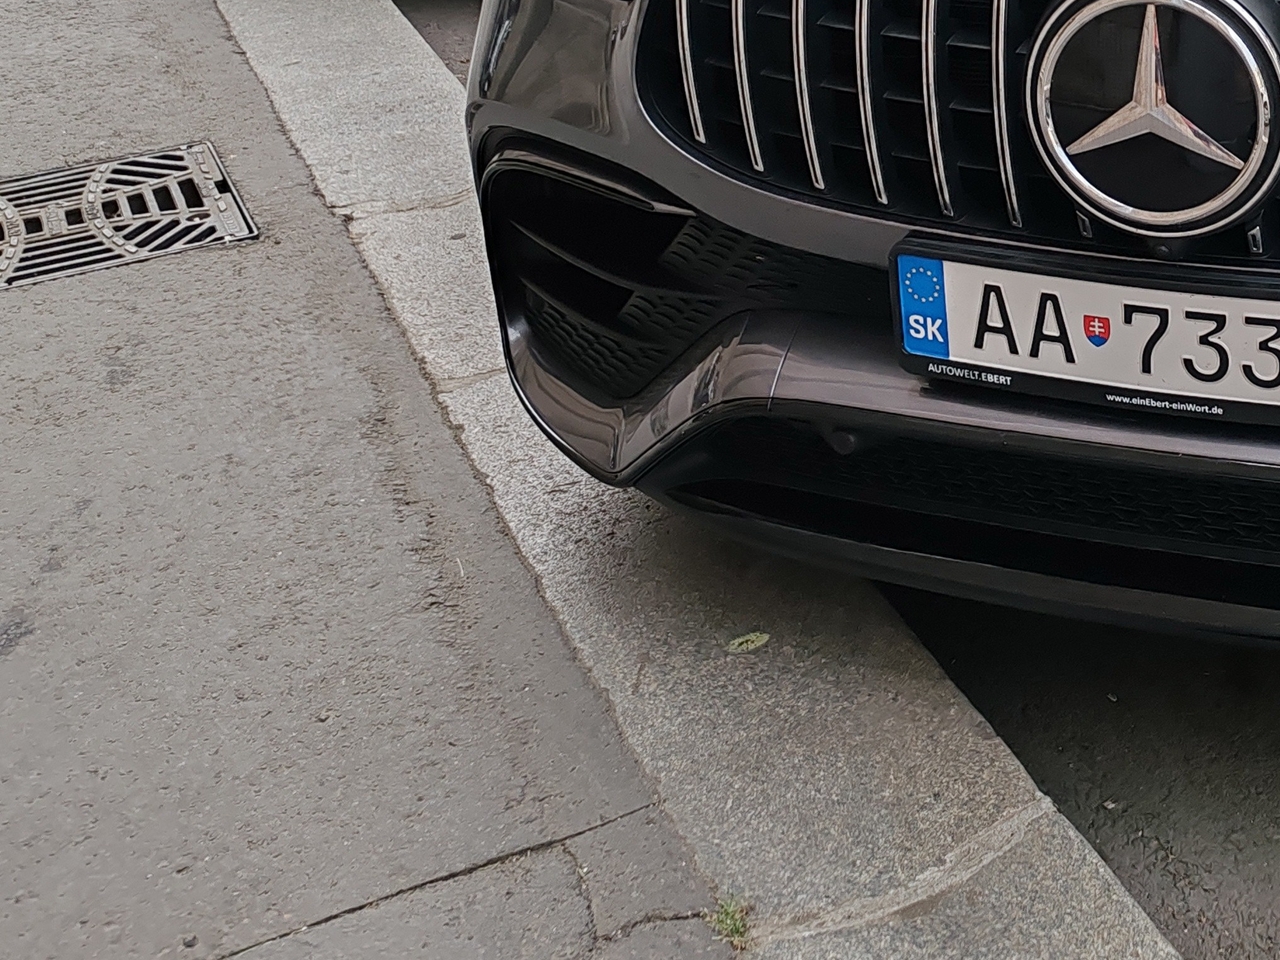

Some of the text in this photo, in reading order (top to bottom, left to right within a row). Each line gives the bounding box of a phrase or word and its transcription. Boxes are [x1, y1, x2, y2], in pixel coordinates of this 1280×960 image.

[908, 314, 945, 343] SK
[928, 362, 1012, 386] AUTOWELT.EBERT
[1105, 393, 1224, 415] www.einEbert-einWort.de
